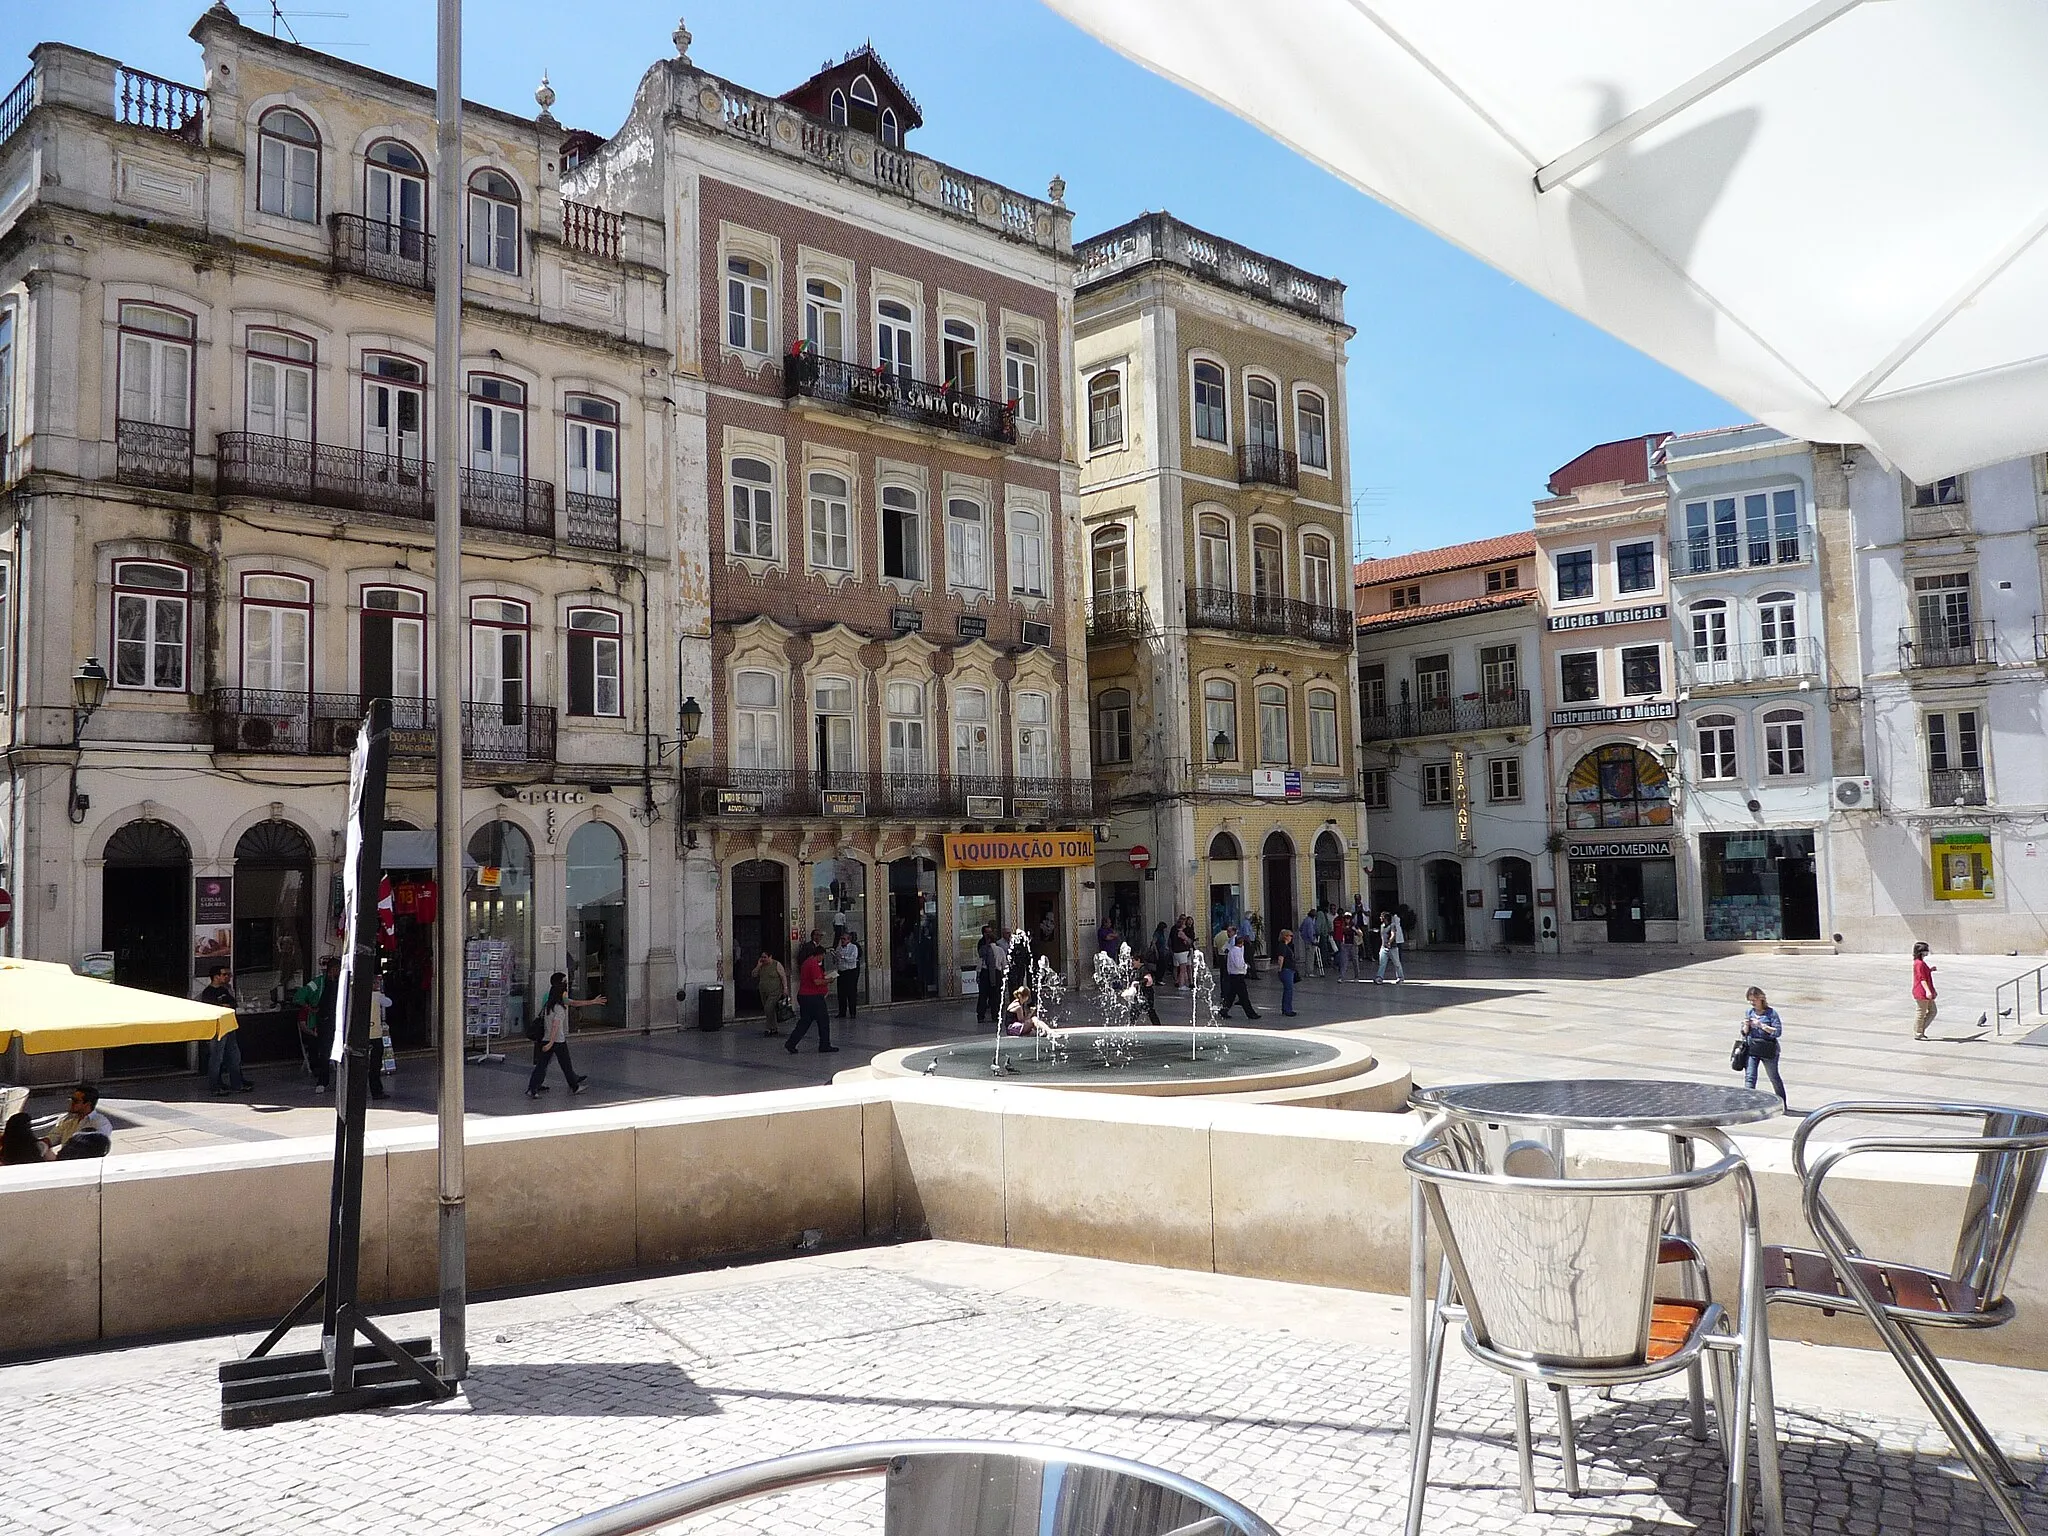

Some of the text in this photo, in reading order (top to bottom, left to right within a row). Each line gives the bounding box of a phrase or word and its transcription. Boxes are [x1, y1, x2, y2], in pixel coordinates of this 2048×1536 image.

[908, 391, 948, 414] SANTA
[952, 402, 985, 423] CRUZ
[1552, 606, 1661, 630] Edições Musicais
[1553, 704, 1672, 724] Instrumentos de Música
[390, 731, 417, 742] COSTA
[833, 804, 856, 814] ADVOGADO
[1907, 814, 2012, 827] FARMACIA
[953, 839, 1094, 862] LIQUIDAÇÃO TOTAL
[1569, 843, 1670, 856] OLIMPIO MEDINA
